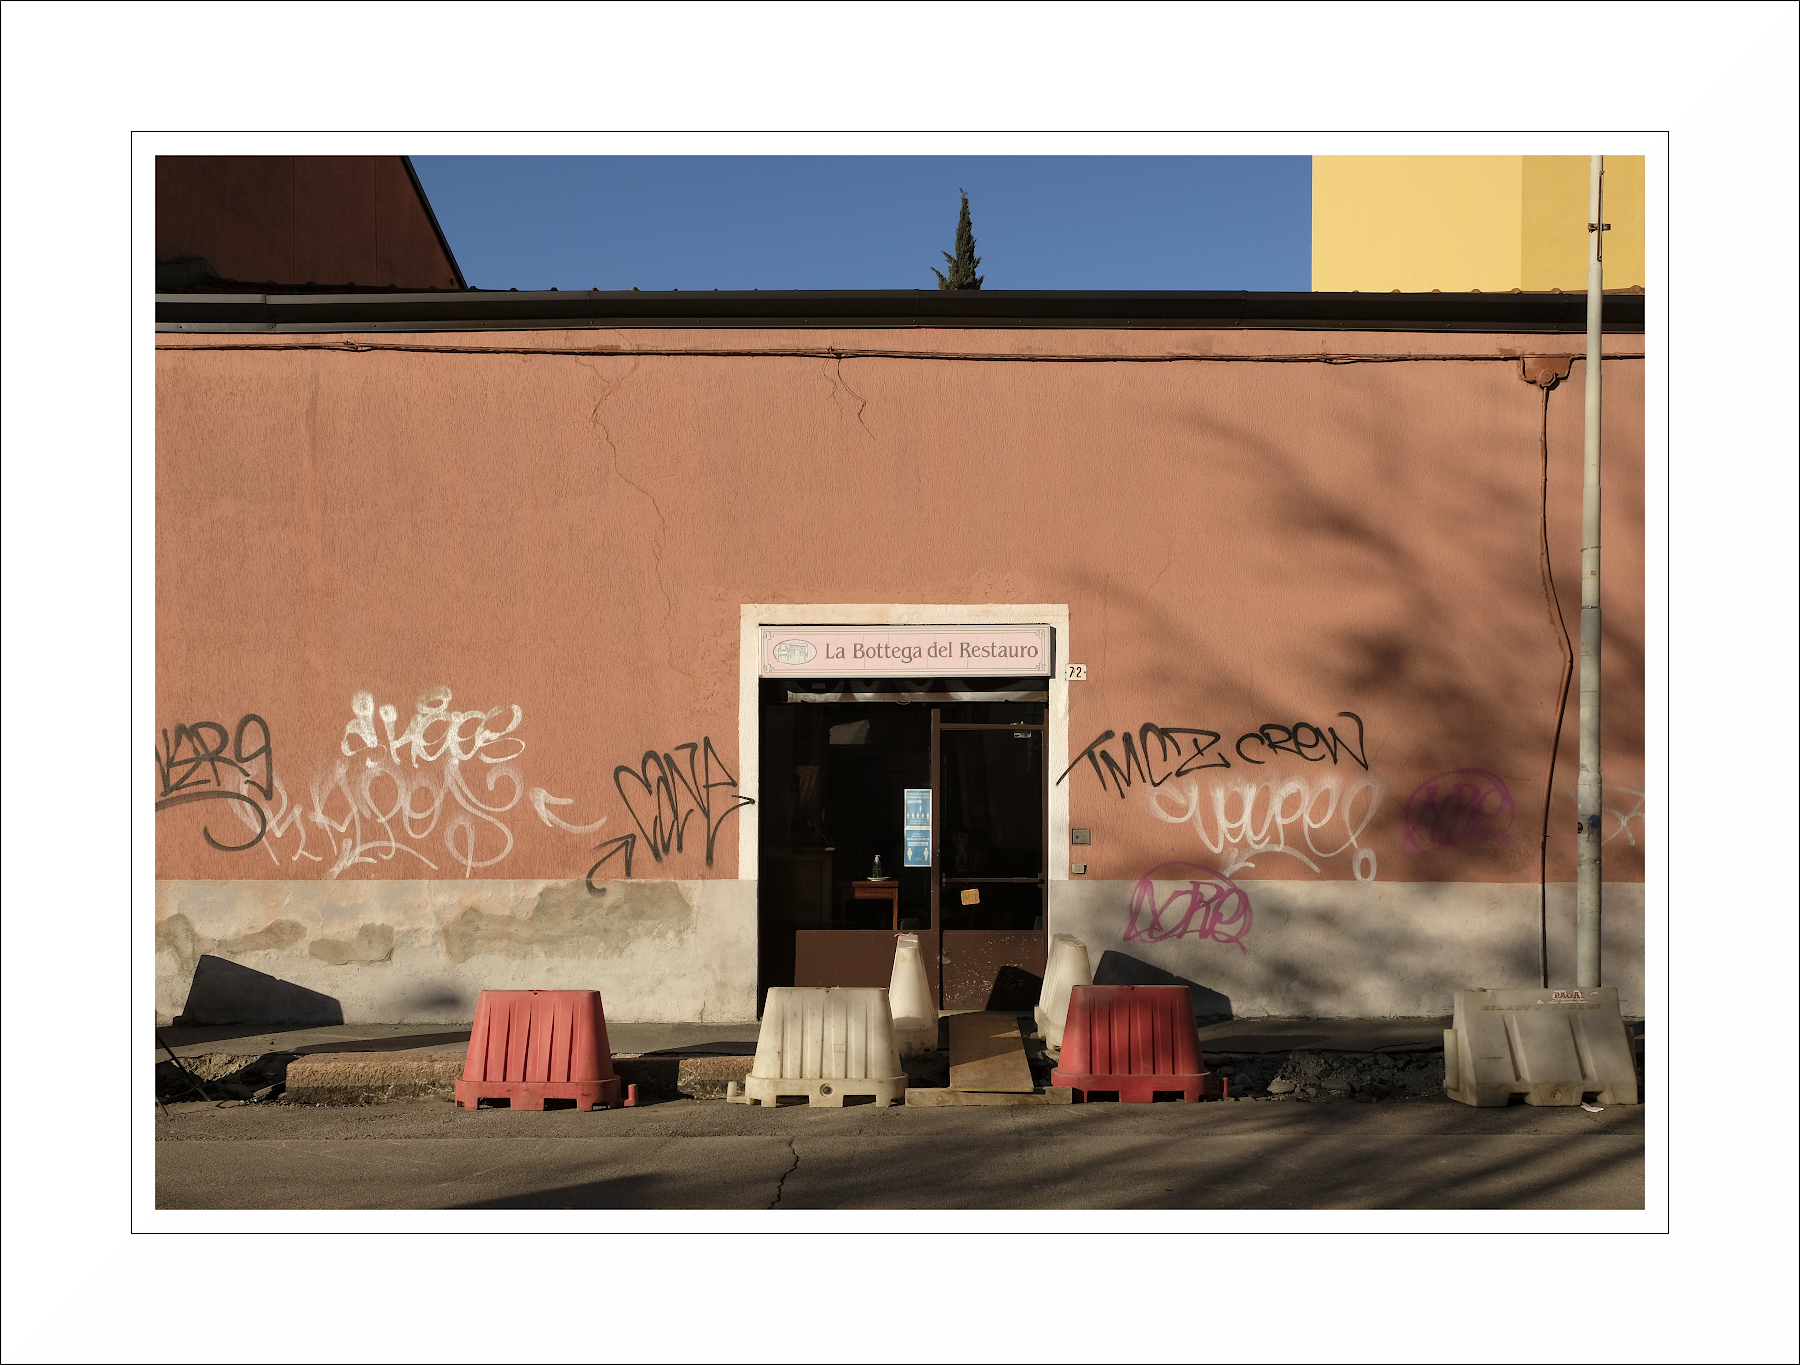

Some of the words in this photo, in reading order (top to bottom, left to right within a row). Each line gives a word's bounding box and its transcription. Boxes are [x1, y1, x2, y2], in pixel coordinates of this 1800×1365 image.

[825, 643, 846, 659] La
[853, 643, 922, 664] Bottega
[927, 641, 953, 658] del
[959, 641, 1039, 659] Restauro
[1068, 665, 1082, 678] 72
